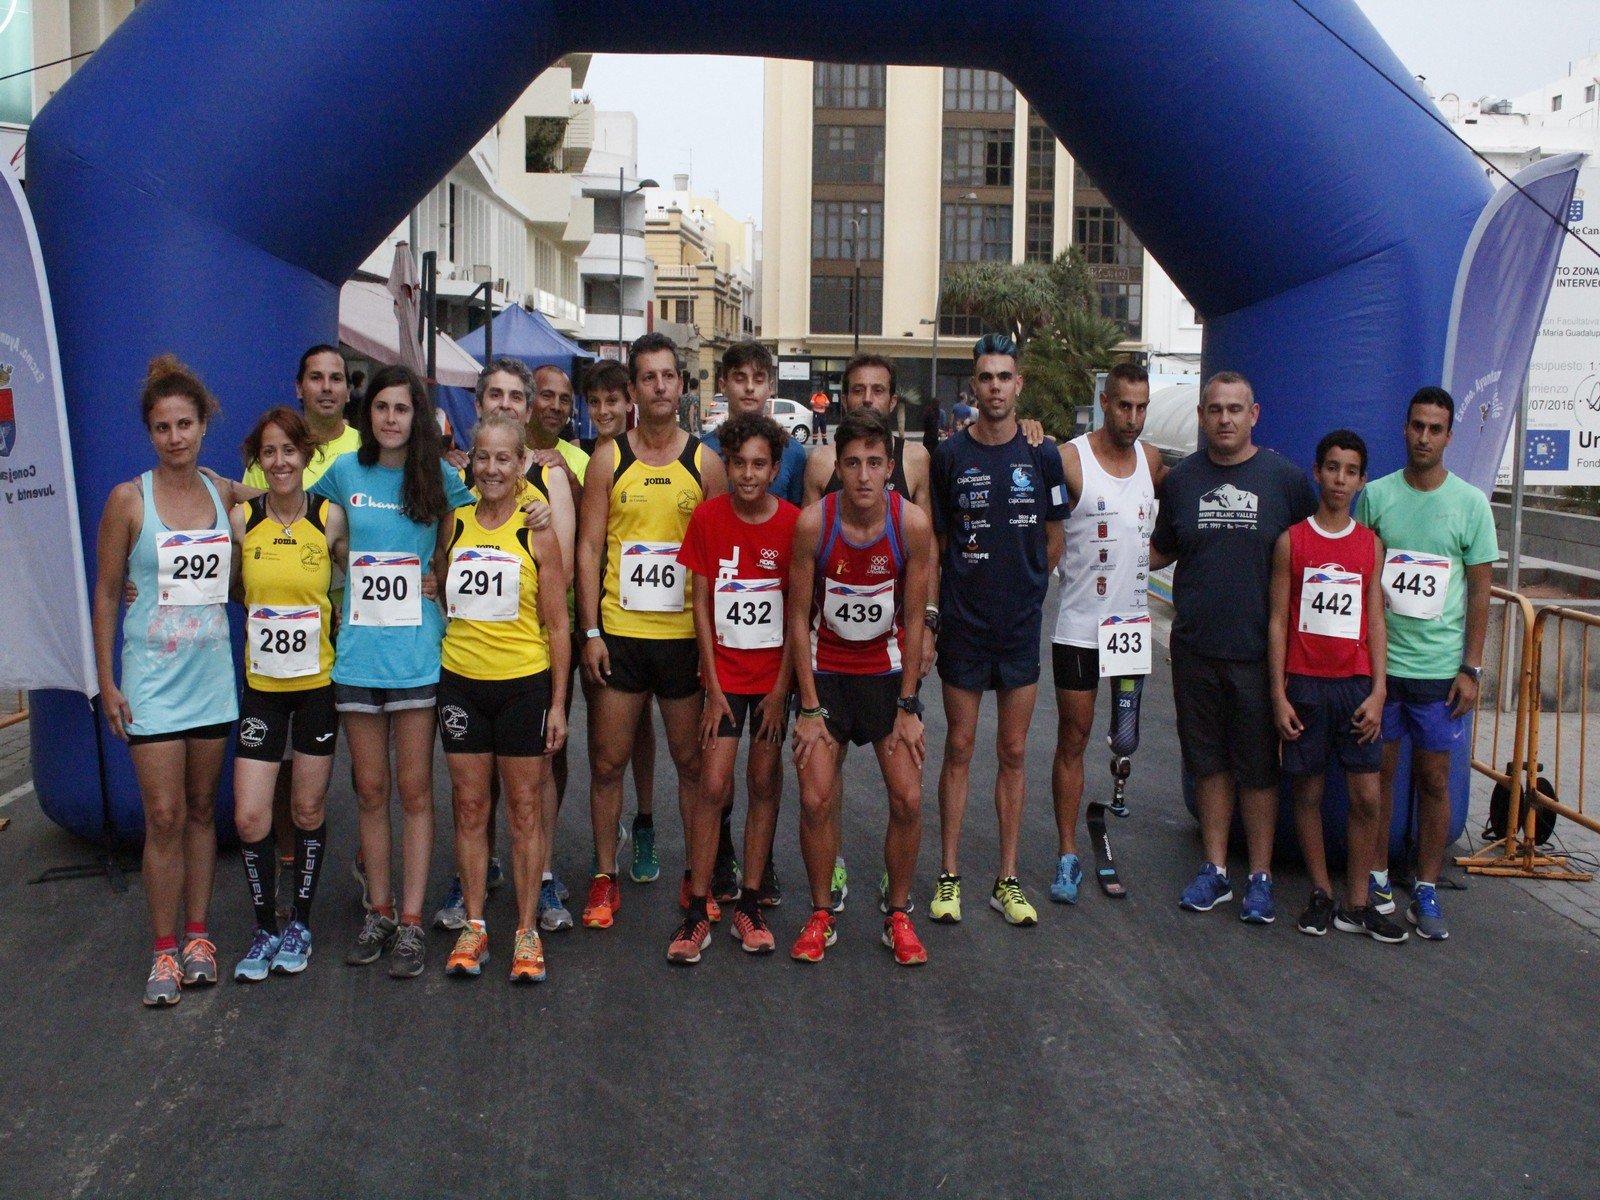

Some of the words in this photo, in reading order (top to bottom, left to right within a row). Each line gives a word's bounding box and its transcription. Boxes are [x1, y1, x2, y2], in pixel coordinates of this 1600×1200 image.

[1572, 267, 1599, 276] ZONA
[172, 554, 219, 579] 292
[630, 564, 675, 588] 446
[362, 575, 408, 601] 290
[458, 570, 502, 596] 291
[1392, 572, 1436, 597] 443
[726, 601, 772, 625] 432
[835, 603, 882, 622] 439
[1312, 592, 1352, 615] 442
[260, 628, 306, 654] 288
[1107, 632, 1142, 654] 433
